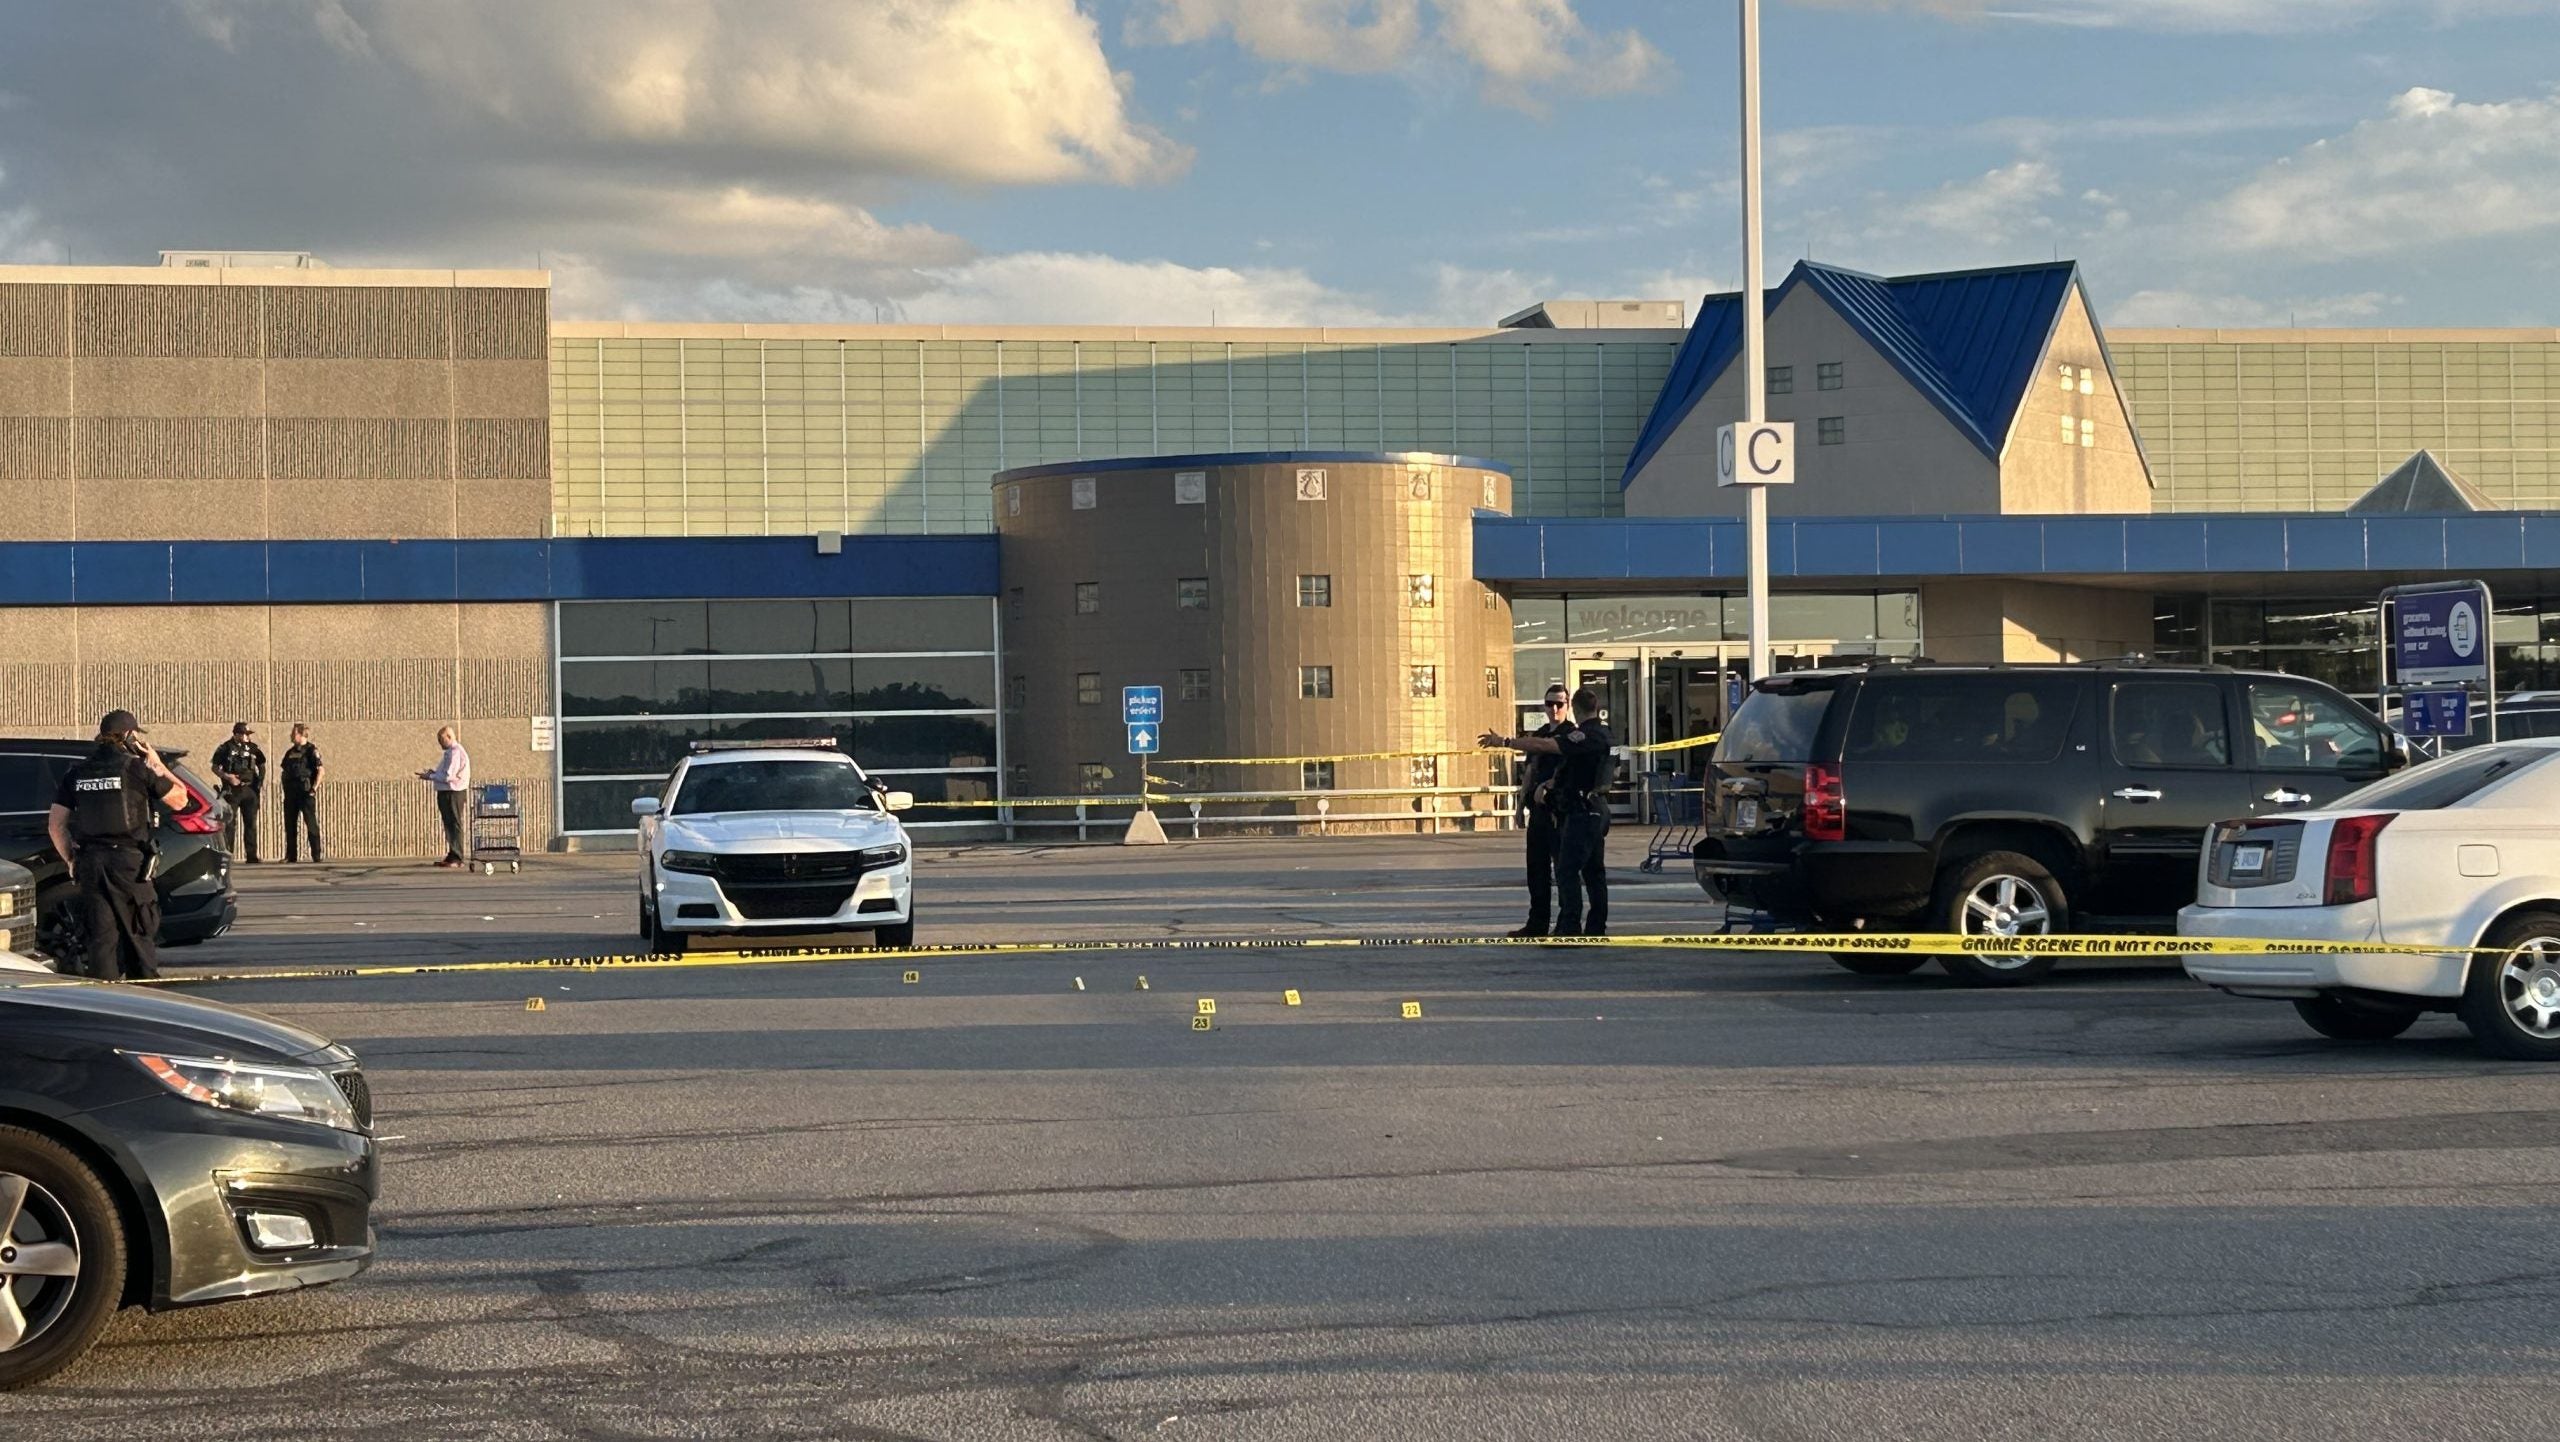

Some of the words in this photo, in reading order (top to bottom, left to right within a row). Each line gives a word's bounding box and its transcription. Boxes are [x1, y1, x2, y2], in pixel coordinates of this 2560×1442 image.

[1721, 430, 1732, 477] C
[1748, 428, 1782, 475] C
[1579, 605, 1707, 629] welcome
[2418, 642, 2429, 650] car
[1129, 696, 1157, 706] pickup
[1130, 707, 1157, 715] orders
[1961, 937, 2021, 951] CRIME
[2023, 938, 2081, 952] SCENE
[2086, 940, 2110, 952] DO
[2114, 940, 2151, 952] NOT
[2153, 940, 2213, 951] CROSS
[622, 953, 683, 963] CROSS
[1201, 1001, 1213, 1011] 21
[1194, 1018, 1208, 1029] 23
